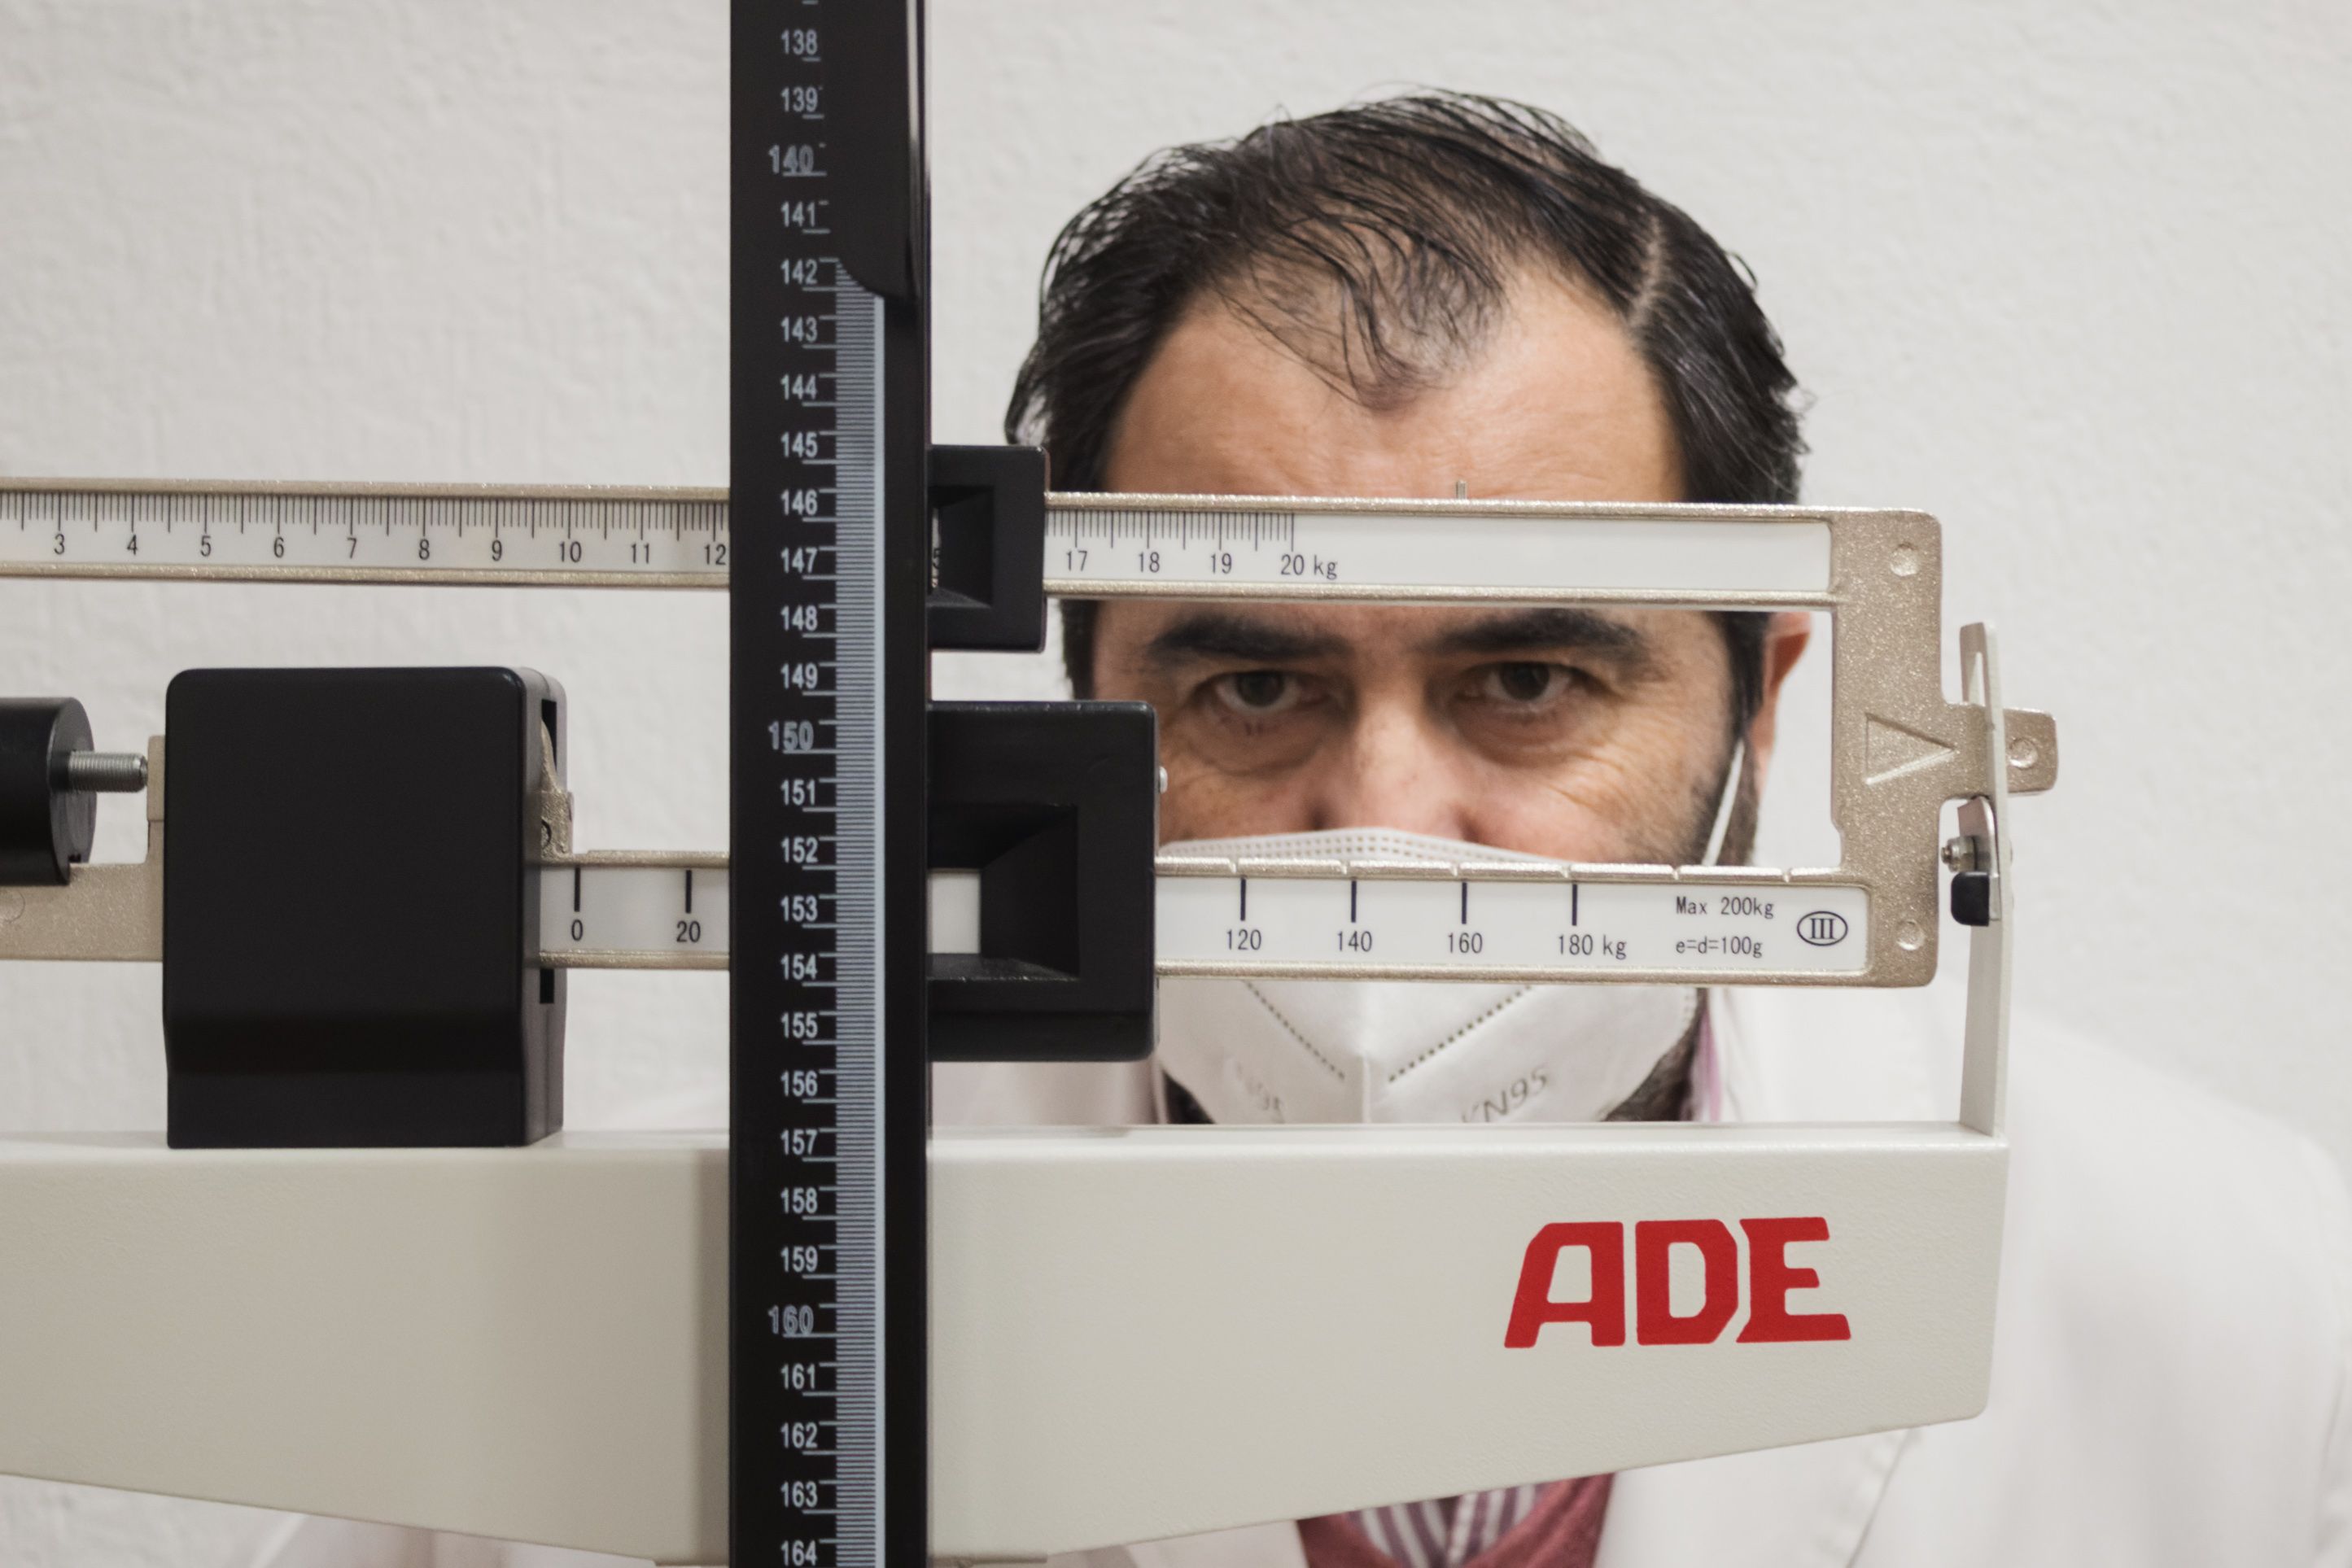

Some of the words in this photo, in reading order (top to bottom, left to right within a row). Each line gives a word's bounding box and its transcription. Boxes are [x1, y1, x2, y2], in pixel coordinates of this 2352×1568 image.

[780, 29, 819, 54] 138
[780, 87, 819, 111] 139
[767, 144, 814, 173] 140
[780, 201, 816, 227] 141
[780, 259, 819, 284] 142
[780, 317, 819, 342] 143
[780, 374, 819, 400] 144
[780, 432, 819, 457] 145
[780, 489, 819, 515] 146
[54, 533, 65, 555] 3
[126, 534, 138, 556] 4
[200, 535, 212, 557] 5
[273, 536, 285, 558] 6
[347, 536, 357, 559] 7
[418, 538, 431, 561] 8
[491, 539, 503, 561] 9
[559, 540, 582, 563] 10
[631, 543, 649, 564] 11
[704, 543, 727, 566] 12
[780, 548, 819, 574] 147
[1066, 549, 1088, 571] 17
[1139, 551, 1161, 574] 18
[1210, 553, 1232, 574] 19
[1280, 553, 1305, 576] 20
[1314, 555, 1337, 580] kg
[780, 605, 819, 631] 148
[780, 663, 819, 689] 149
[767, 721, 814, 750] 150
[780, 780, 816, 806] 151
[780, 837, 819, 863] 152
[780, 896, 819, 921] 153
[1676, 896, 1707, 915] Max
[1720, 896, 1774, 919] 200kg
[571, 919, 584, 941] 0
[676, 920, 702, 943] 20
[1226, 928, 1262, 950] 120
[1338, 930, 1373, 953] 140
[1448, 932, 1483, 954] 160
[1559, 933, 1594, 956] 180
[1602, 935, 1627, 961] kg
[1676, 936, 1763, 959] e=d=100g
[780, 954, 819, 980] 154
[780, 1012, 819, 1038] 155
[780, 1071, 819, 1096] 156
[780, 1129, 819, 1155] 157
[780, 1187, 819, 1213] 158
[780, 1247, 819, 1272] 159
[1504, 1216, 1851, 1348] ADE
[767, 1304, 814, 1334] 160
[780, 1364, 816, 1389] 161
[780, 1422, 819, 1448] 162
[780, 1481, 819, 1507] 163
[780, 1540, 819, 1566] 164
